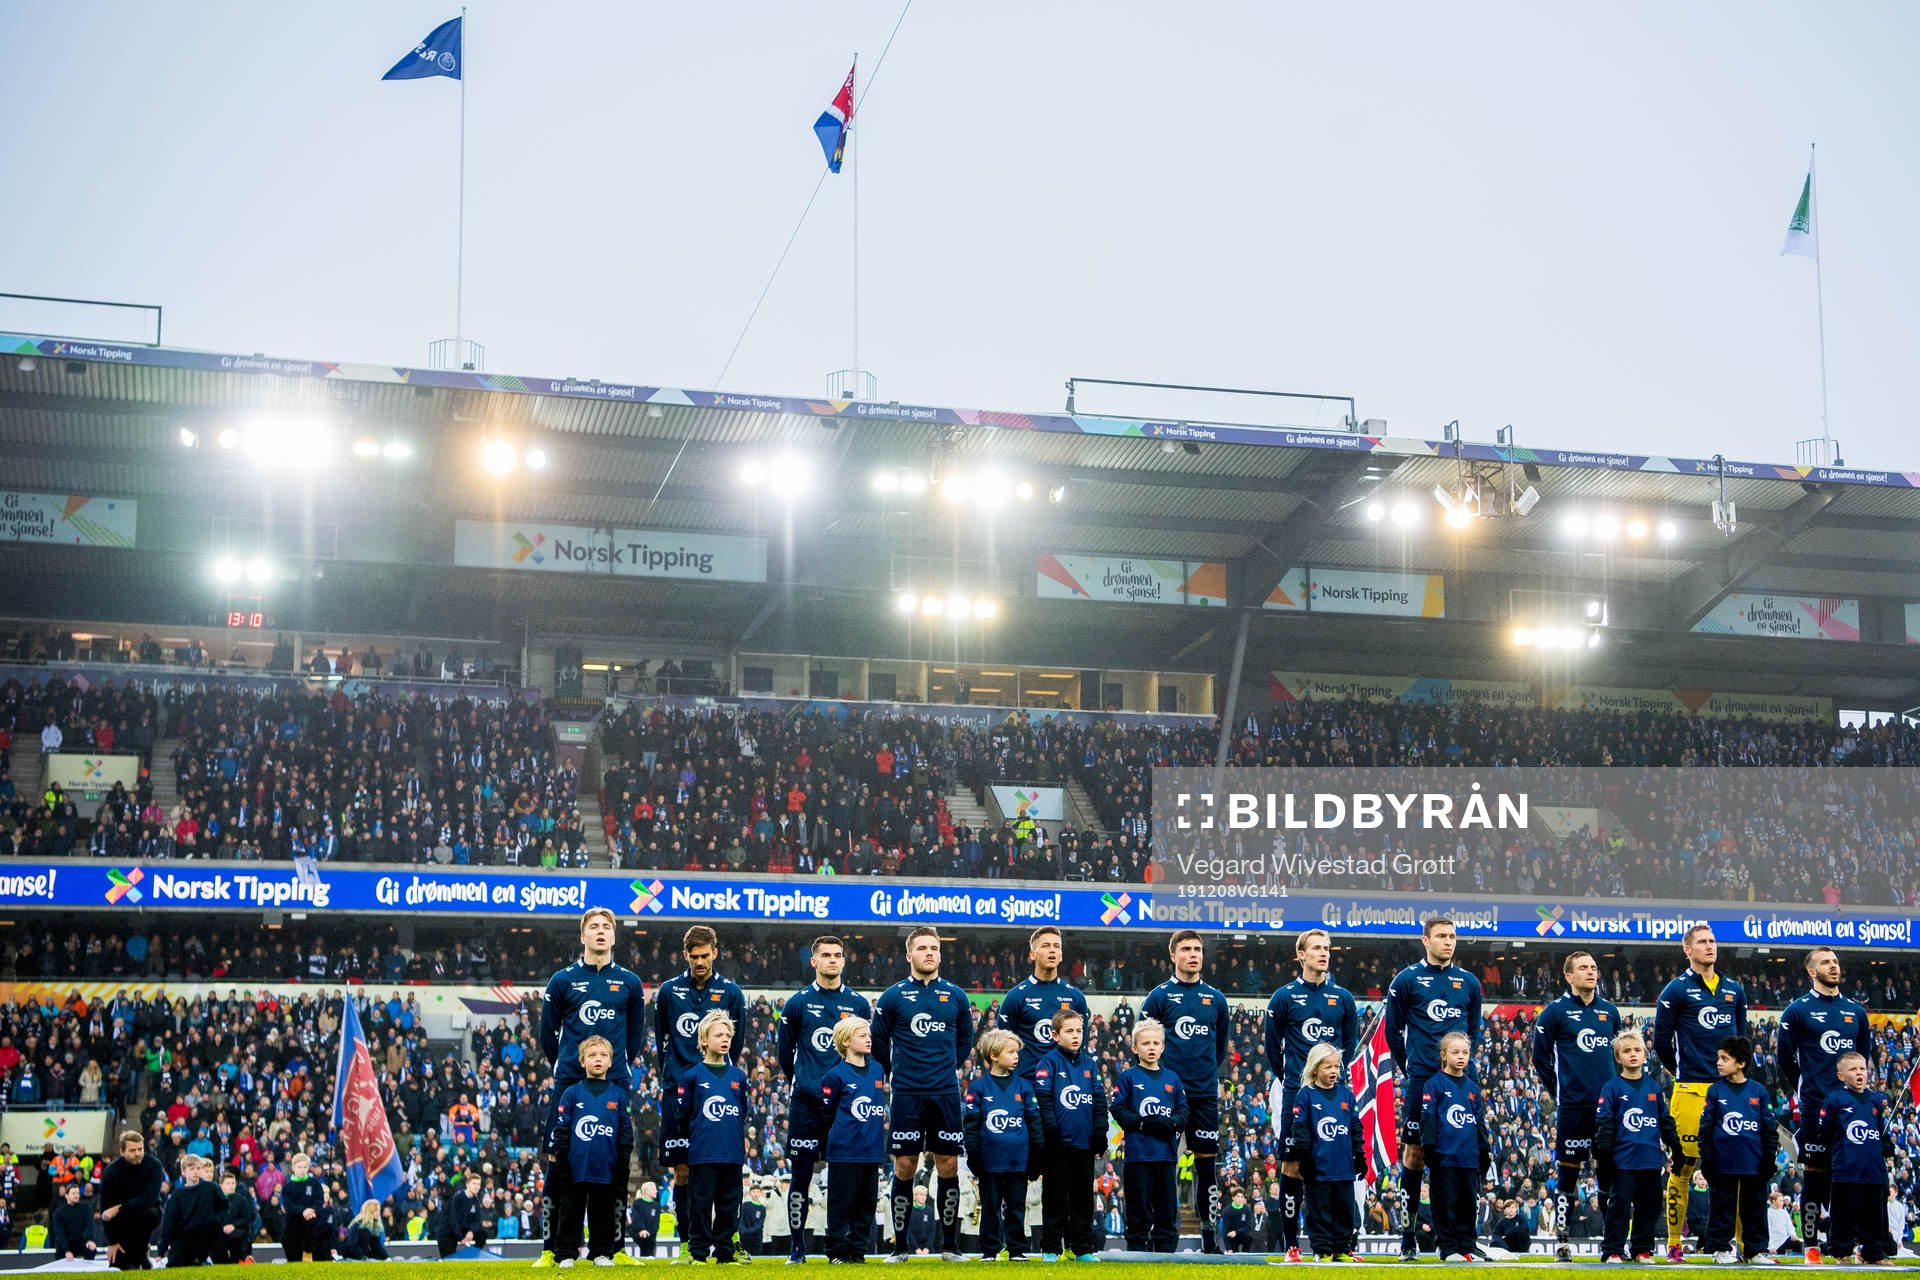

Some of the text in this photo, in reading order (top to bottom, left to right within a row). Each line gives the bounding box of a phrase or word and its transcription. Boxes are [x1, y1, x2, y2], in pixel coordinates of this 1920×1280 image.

[69, 345, 132, 360] Norsk Tipping
[728, 396, 781, 409] Norsk Tipping
[1166, 427, 1216, 439] Norsk Tipping
[1729, 465, 1753, 475] Tipping
[5, 494, 19, 508] Gi
[9, 519, 55, 540] sjanse!
[555, 539, 713, 573] Norsk Tipping
[1121, 560, 1132, 573] Gi
[1103, 567, 1153, 587] drømmen
[1113, 583, 1161, 601] en sjanse!
[1322, 586, 1408, 605] Norsk Tipping
[1764, 597, 1773, 608] Gi
[1747, 603, 1793, 623] drømmen
[1757, 617, 1801, 634] en sjanse!
[1315, 682, 1349, 695] Norsk
[1351, 684, 1392, 699] Tipping
[153, 874, 230, 900] Norsk
[234, 876, 331, 907] Tipping
[376, 876, 399, 905] Gi
[405, 877, 488, 904] drømmen
[492, 883, 516, 903] en
[520, 880, 588, 911] sjanse!
[671, 886, 740, 912] Norsk
[743, 888, 830, 917] Tipping
[870, 889, 892, 915] Gi
[897, 890, 972, 917] drømmen
[975, 897, 997, 915] en
[1000, 893, 1062, 923] sjanse!
[1138, 901, 1203, 923] Norsk
[1205, 902, 1284, 928] Tipping
[1321, 902, 1342, 928] Gi
[1346, 901, 1416, 927] drømmen
[1572, 911, 1631, 933] Norsk
[1743, 914, 1763, 939] Gi
[1767, 913, 1833, 939] drømmen
[1836, 917, 1855, 938] en
[1858, 917, 1912, 946] sjanse!
[860, 1105, 884, 1118] Lyse
[790, 1138, 818, 1150] coop
[892, 1130, 921, 1142] coop
[938, 1130, 964, 1142] coop
[1564, 1139, 1592, 1149] coop
[790, 1191, 806, 1230] coop
[894, 1195, 911, 1232] coop
[943, 1188, 959, 1227] coop
[1667, 1185, 1682, 1227] coop
[1804, 1201, 1818, 1239] coop
